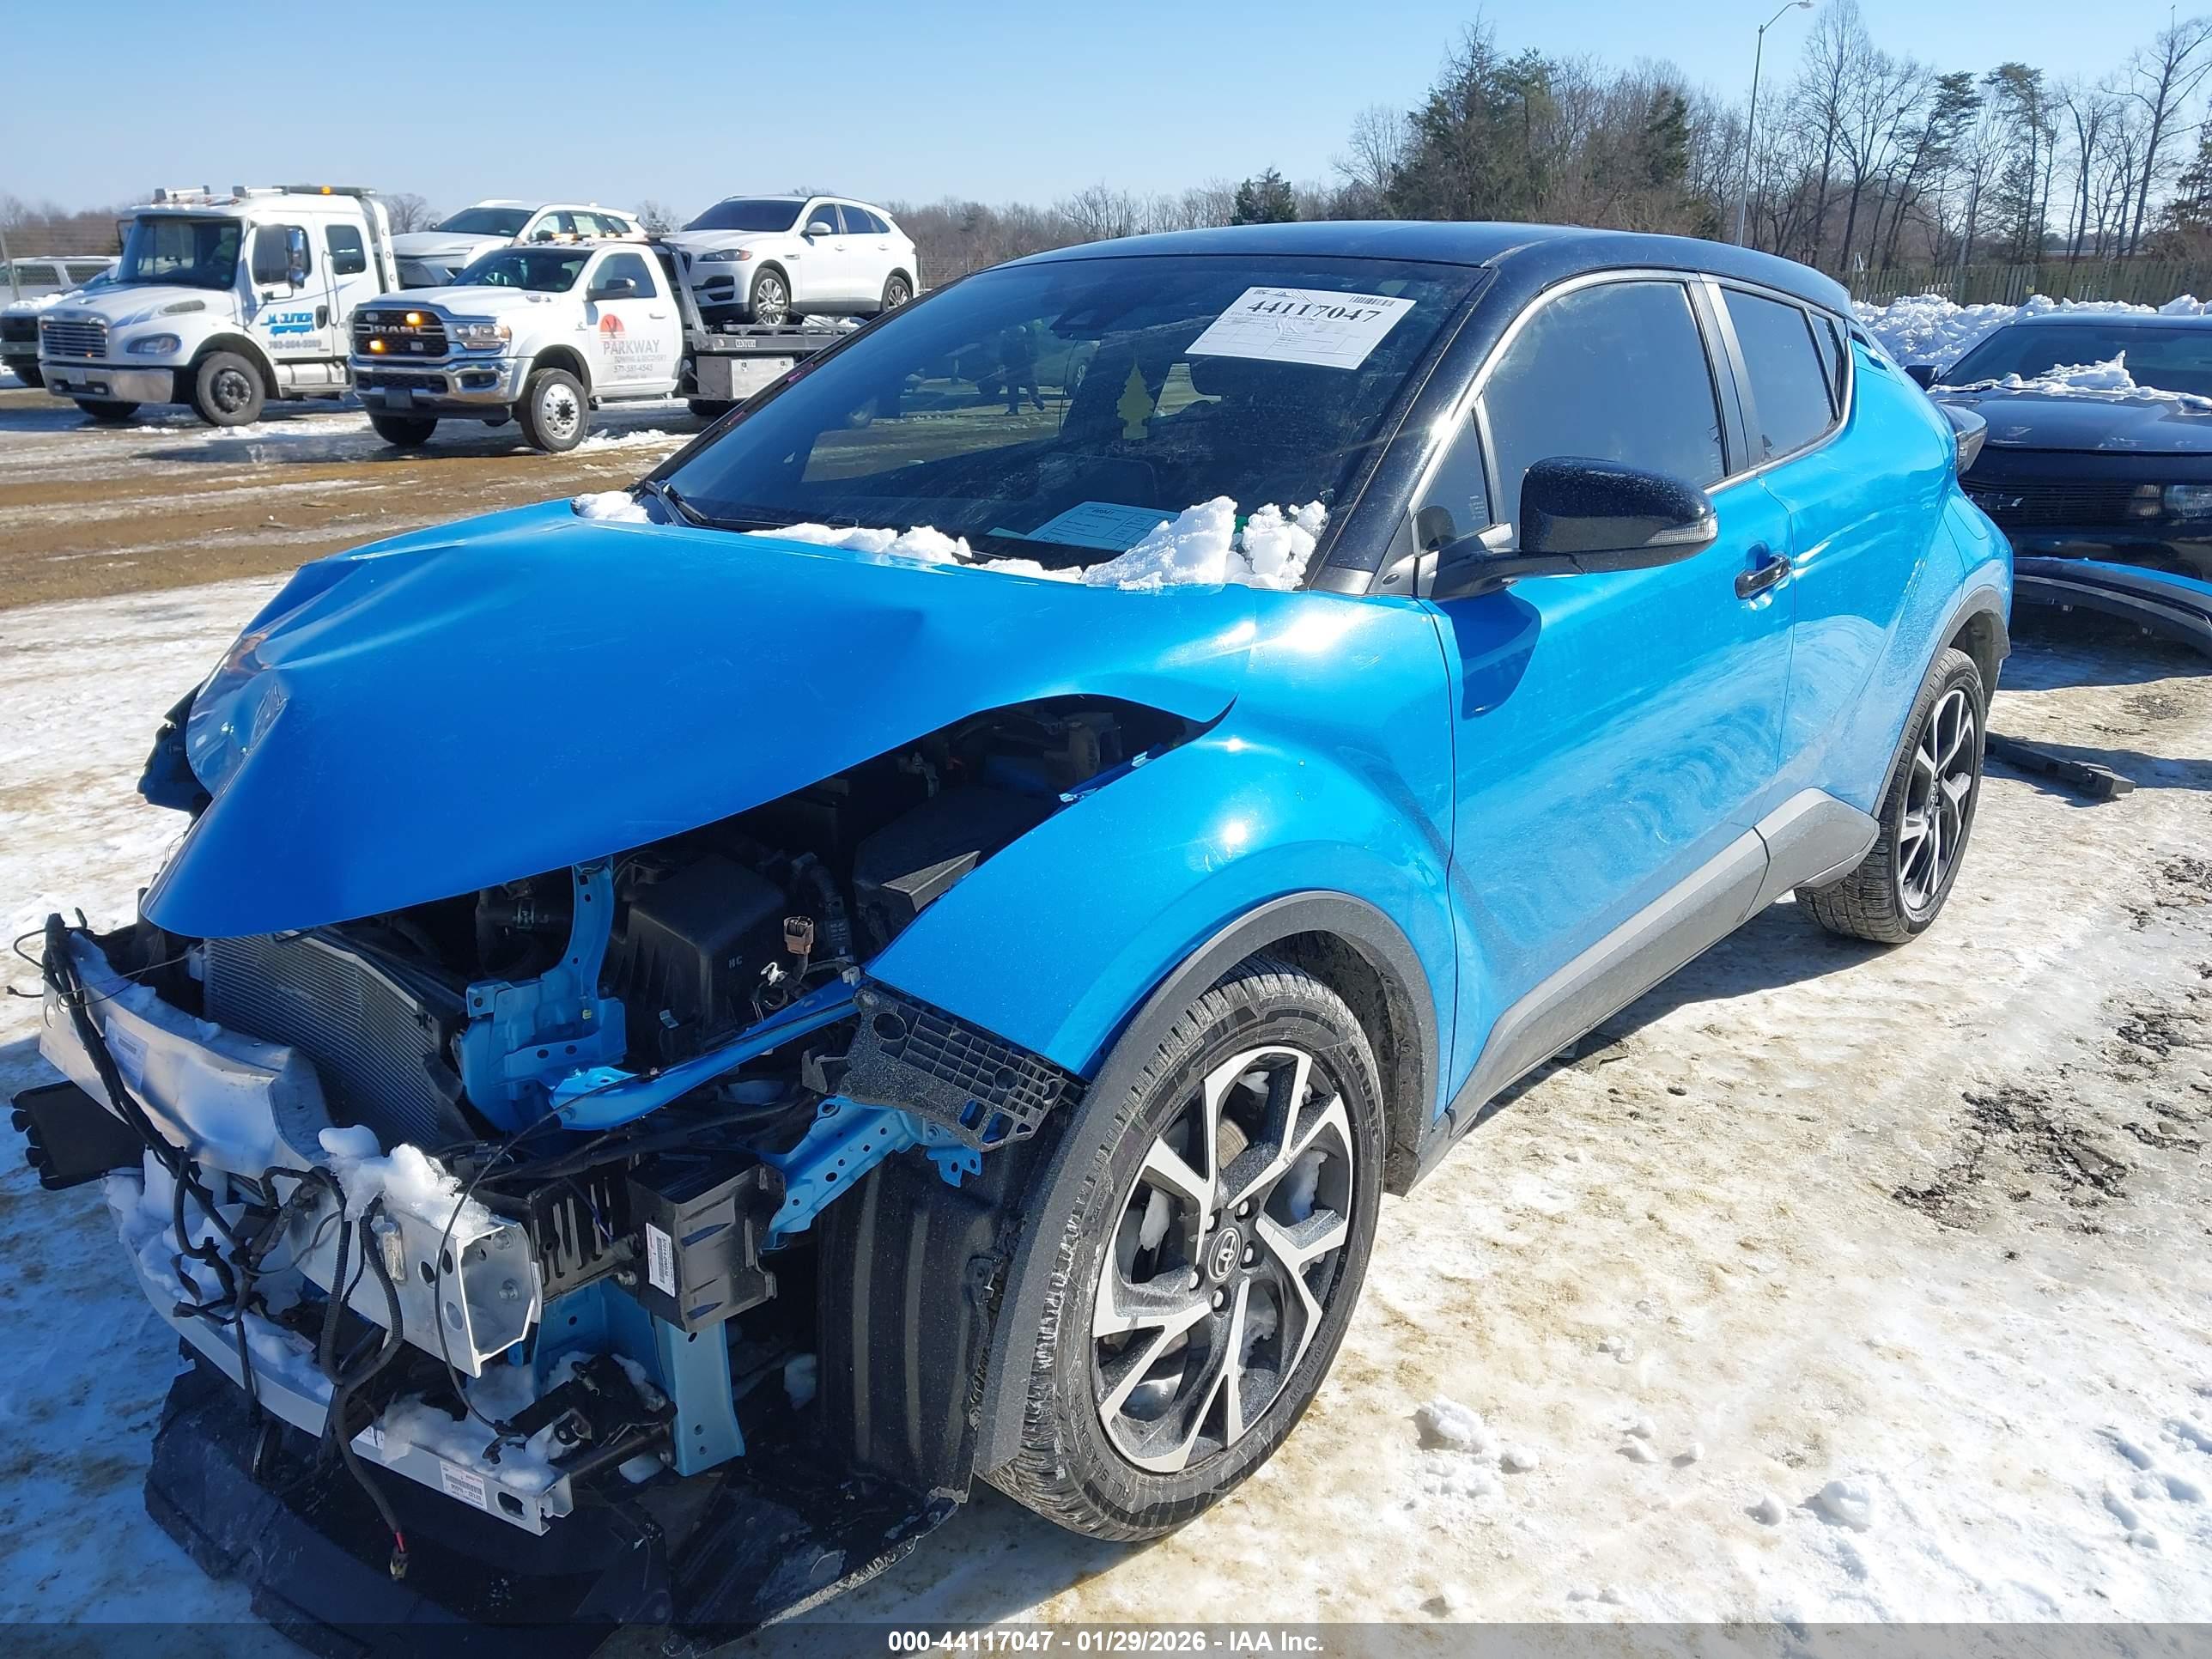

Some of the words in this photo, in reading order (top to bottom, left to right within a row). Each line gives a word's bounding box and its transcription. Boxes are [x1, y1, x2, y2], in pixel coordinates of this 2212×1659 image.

[1247, 300, 1383, 323] 44117047
[604, 339, 659, 356] PARKWAY
[1078, 1420, 1110, 1482] SEASON
